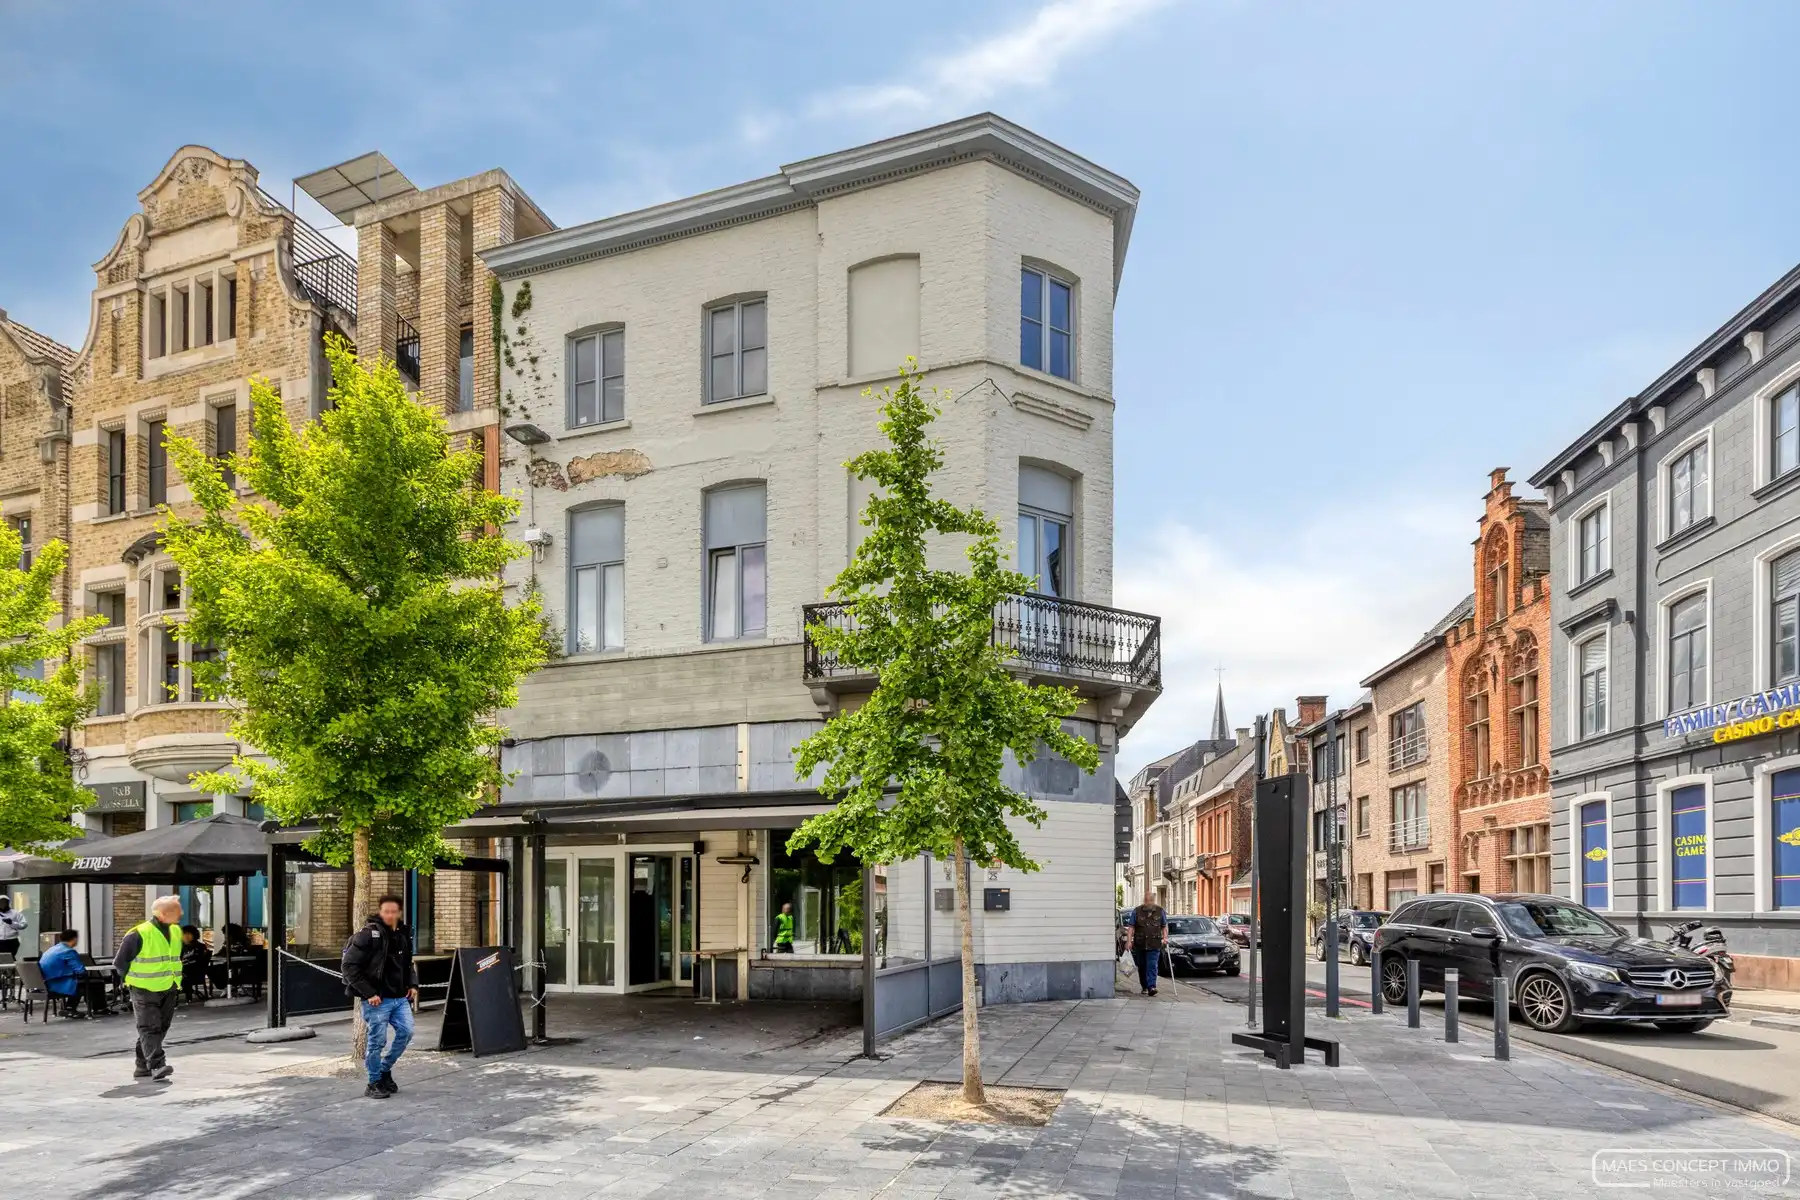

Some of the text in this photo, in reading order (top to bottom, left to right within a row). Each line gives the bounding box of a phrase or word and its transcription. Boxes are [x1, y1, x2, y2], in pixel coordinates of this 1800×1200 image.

[1663, 701, 1733, 739] FAMILY
[1713, 716, 1775, 744] CASINO
[71, 856, 112, 871] PETRUS
